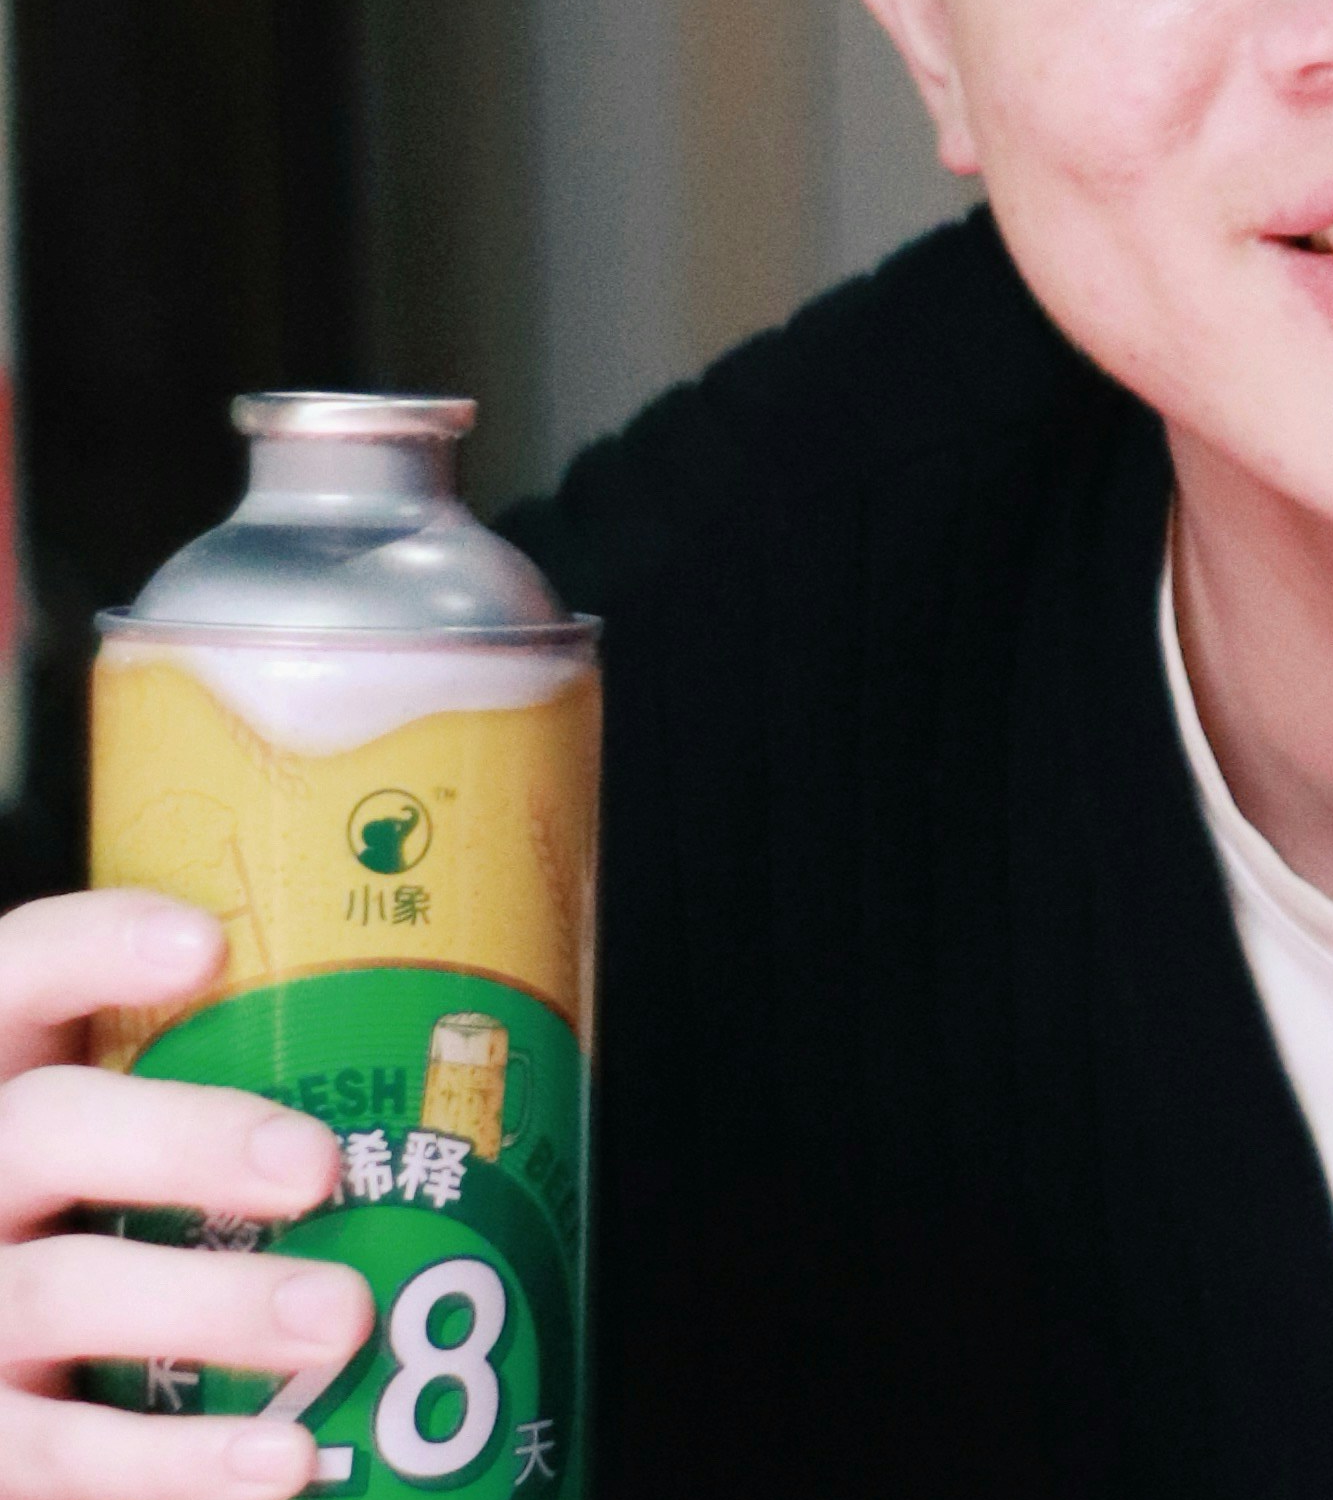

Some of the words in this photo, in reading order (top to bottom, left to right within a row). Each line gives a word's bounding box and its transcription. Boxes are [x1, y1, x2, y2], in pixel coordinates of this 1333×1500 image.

[346, 883, 432, 926] 小象
[262, 1067, 407, 1123] ESH
[514, 1418, 556, 1486] 天
